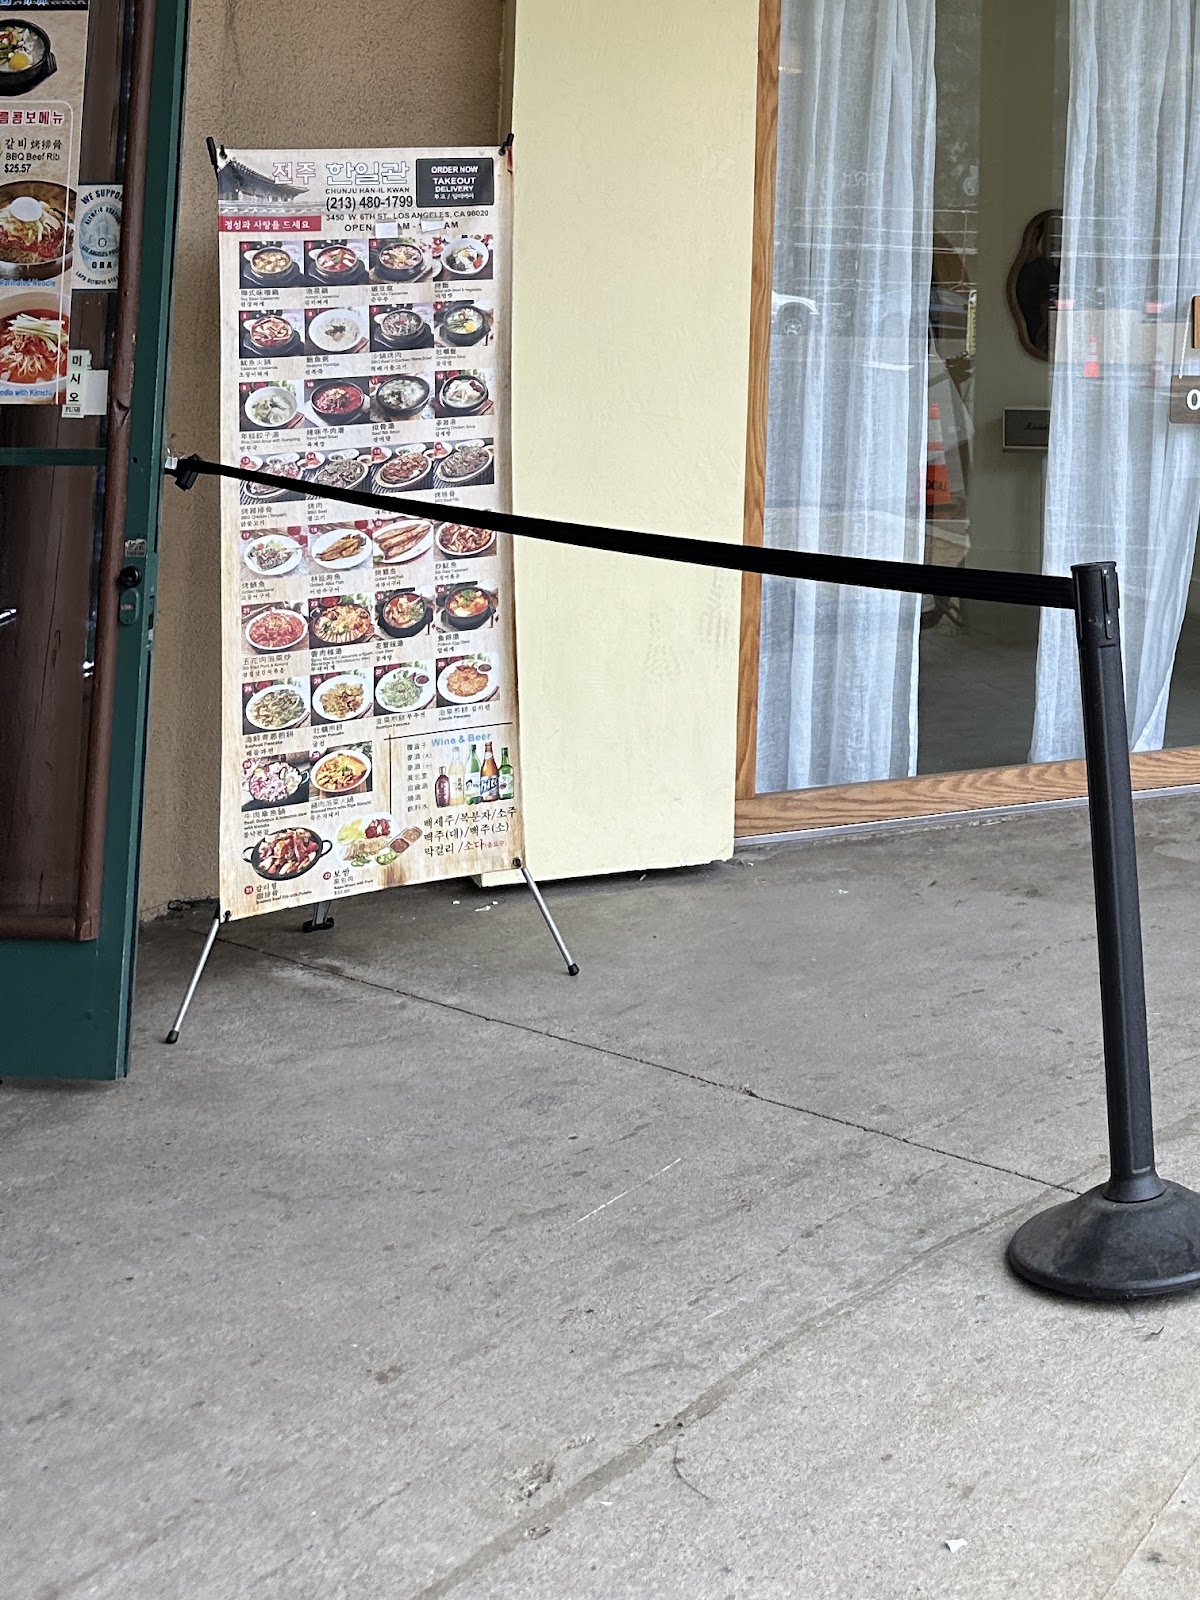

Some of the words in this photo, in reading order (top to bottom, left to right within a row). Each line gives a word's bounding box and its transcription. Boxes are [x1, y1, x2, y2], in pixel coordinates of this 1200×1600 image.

[6, 153, 25, 161] BBQ
[26, 153, 46, 161] Beef
[46, 153, 60, 161] Rib
[4, 164, 31, 173] $25.57
[272, 162, 316, 185] 전주
[325, 161, 410, 185] 한일관
[431, 166, 459, 174] ORDER
[460, 166, 479, 174] NOW
[433, 177, 476, 185] TAKEOUT
[81, 192, 95, 205] WE
[326, 197, 356, 211] (213)
[359, 196, 413, 208] 480-1799
[69, 354, 83, 402] 미시오
[431, 738, 456, 747] Wine
[458, 735, 465, 743] &
[467, 733, 492, 742] Beer
